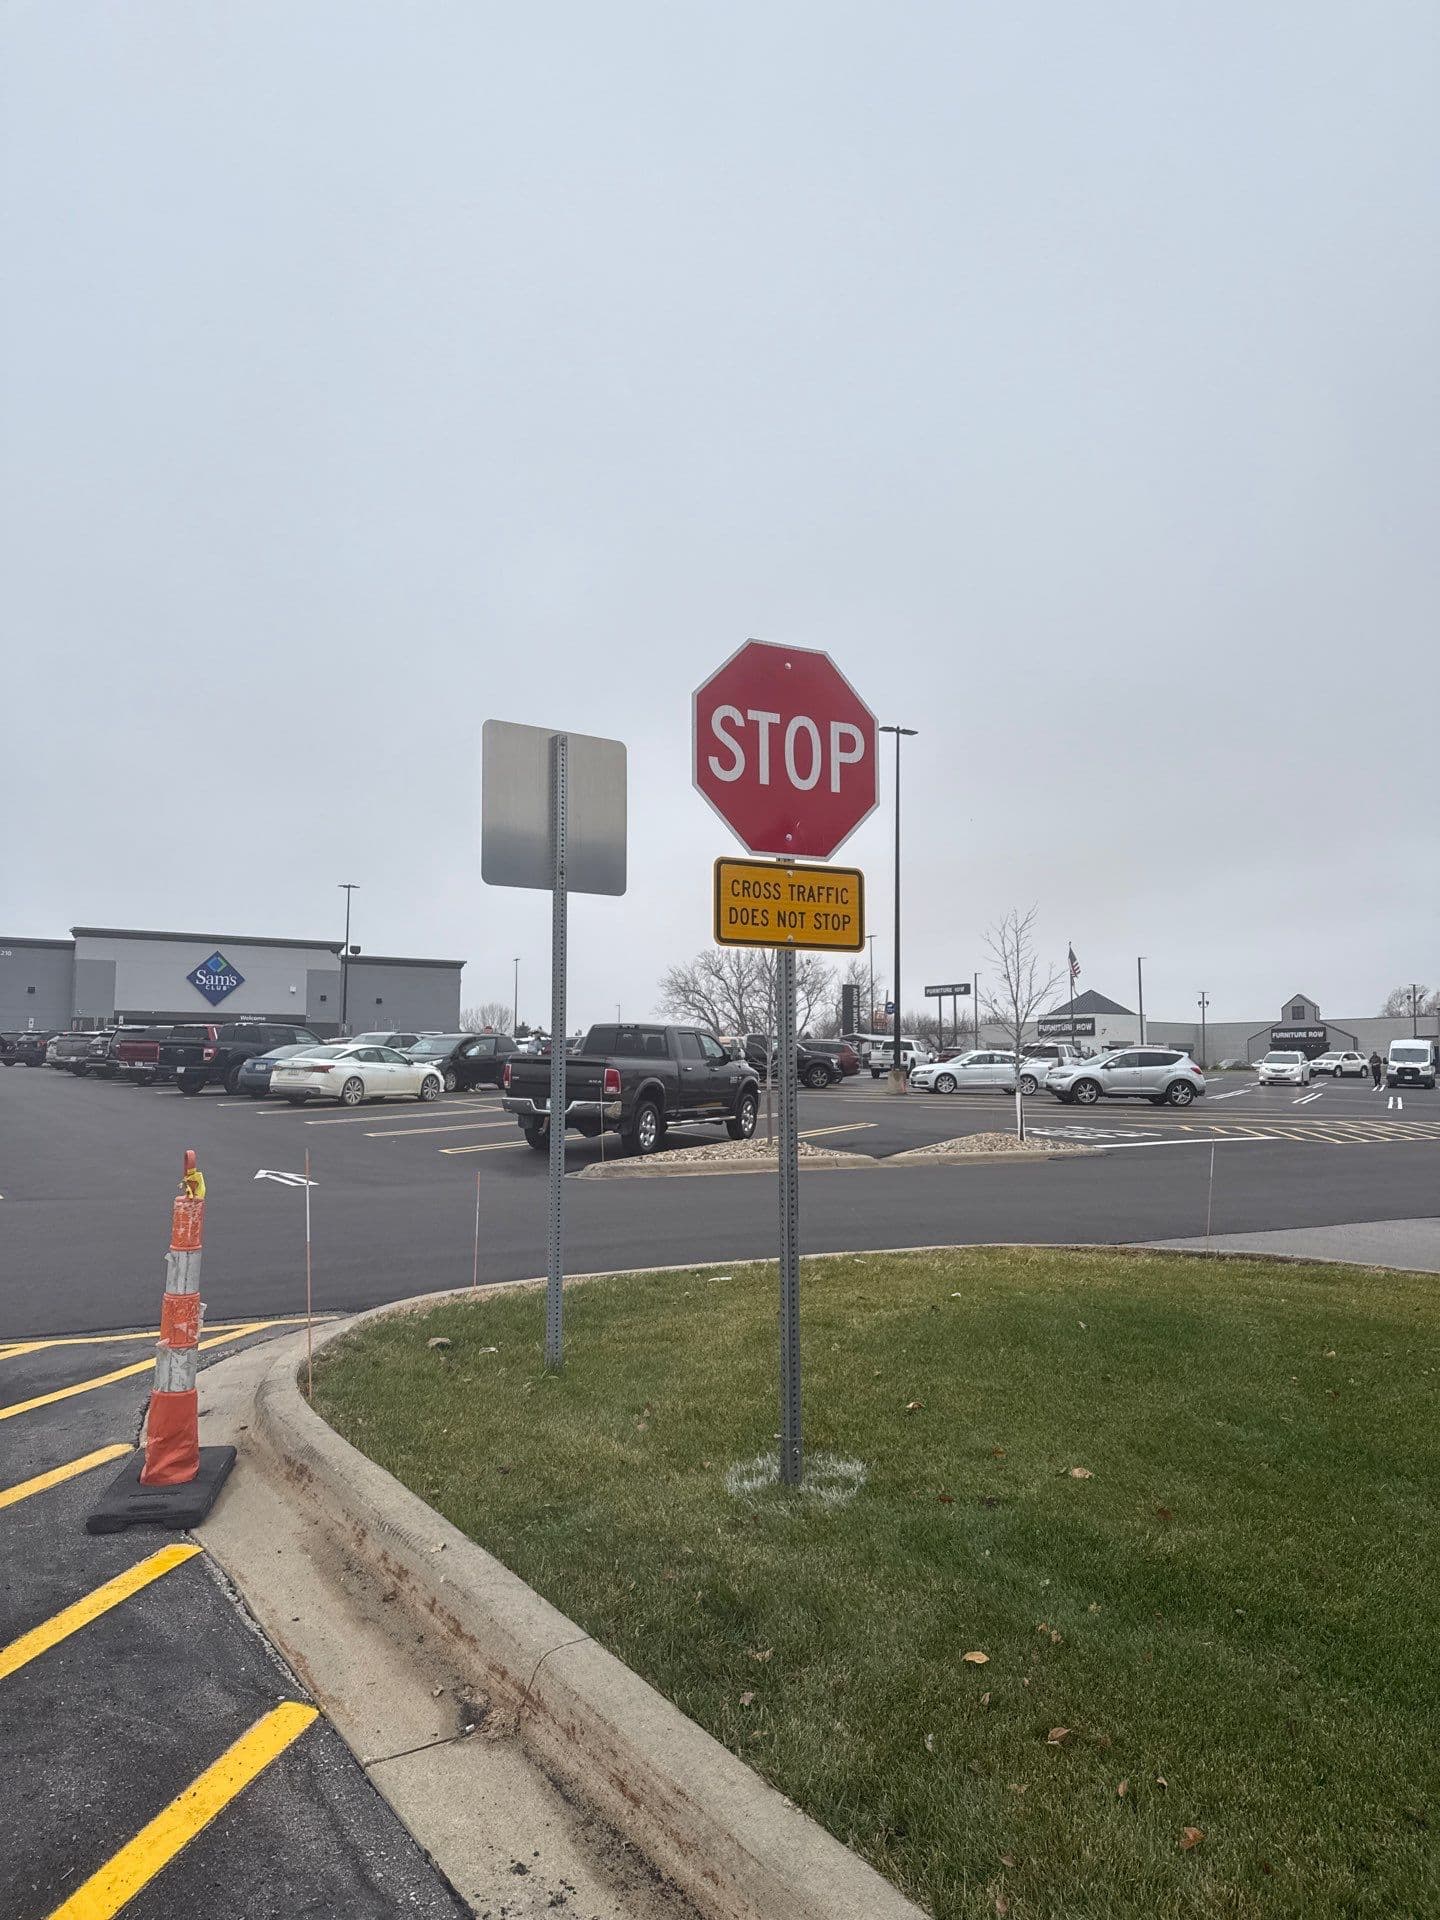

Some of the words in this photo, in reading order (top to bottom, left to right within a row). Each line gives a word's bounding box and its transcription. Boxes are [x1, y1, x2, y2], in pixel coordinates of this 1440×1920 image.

[708, 704, 865, 793] STOP
[731, 879, 781, 900] CROSS
[788, 884, 849, 905] TRAFFIC
[729, 907, 769, 927] DOES
[777, 910, 806, 929] NOT
[813, 912, 851, 931] STOP
[195, 969, 237, 987] Sam's
[1076, 1022, 1093, 1031] ROW
[1271, 1031, 1307, 1039] FURNITURE
[1308, 1030, 1324, 1038] ROW
